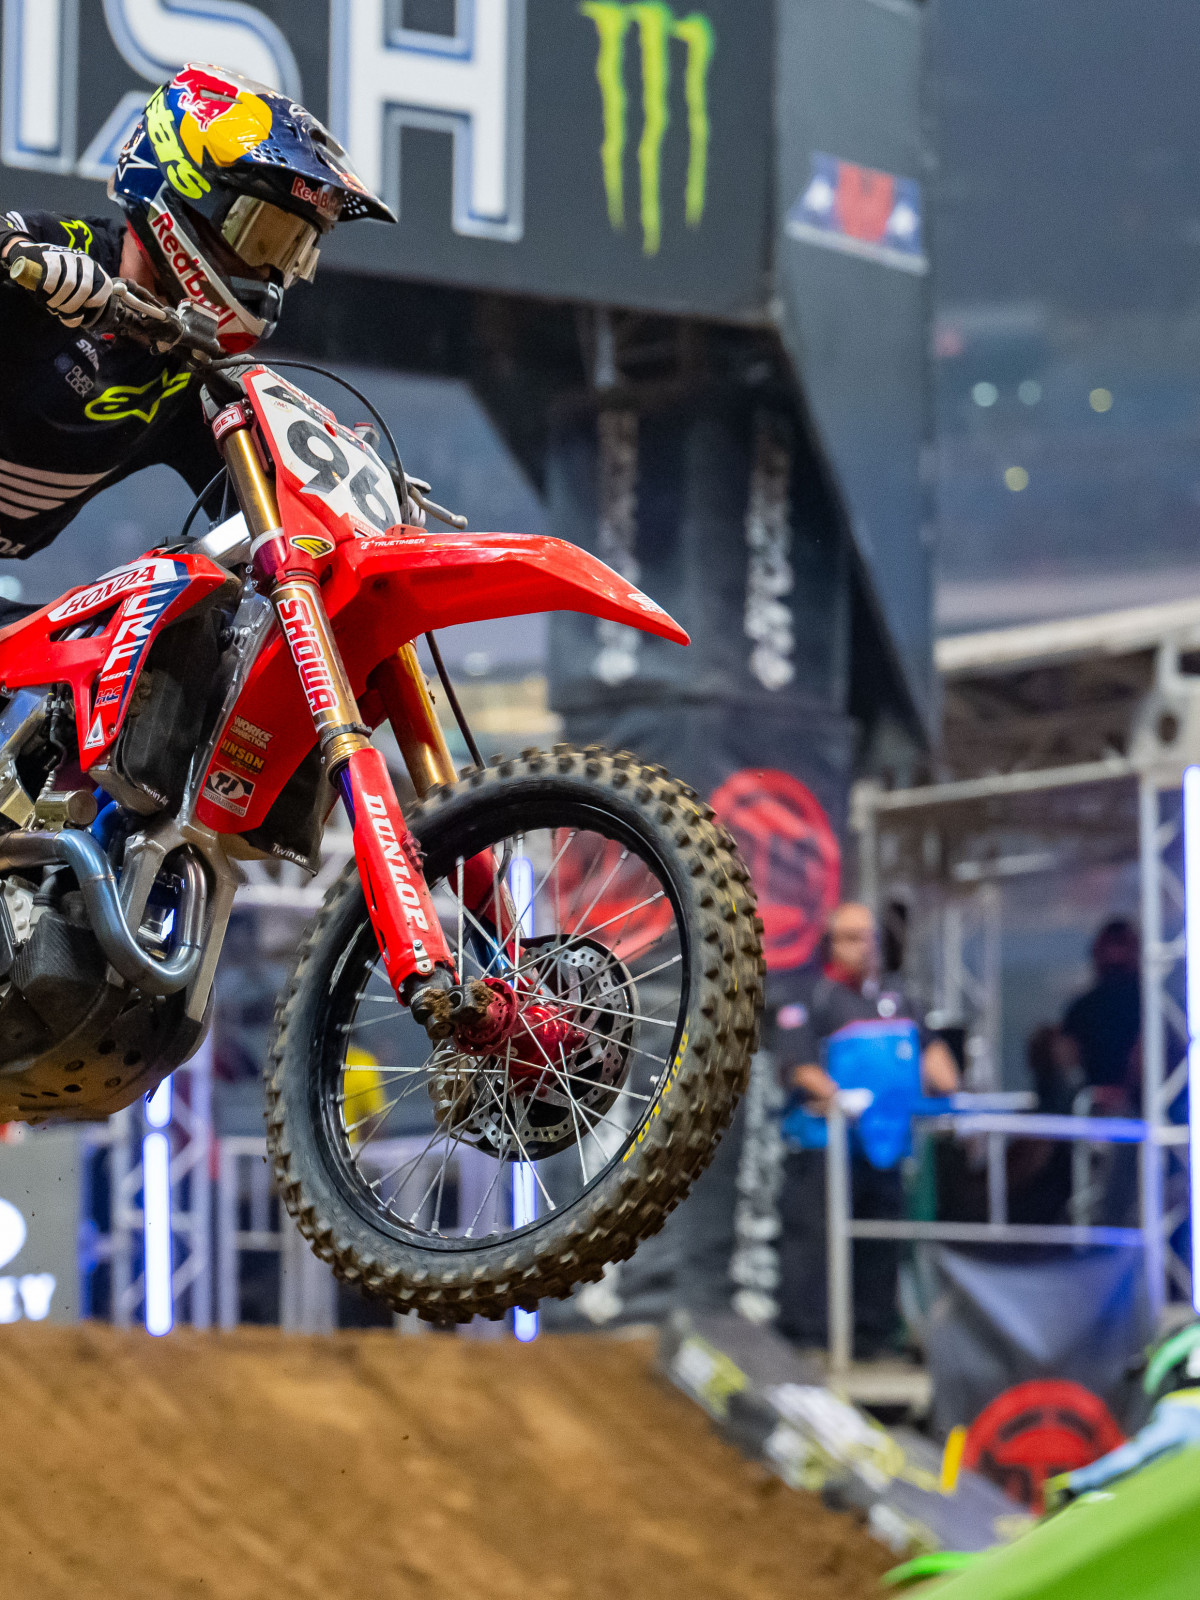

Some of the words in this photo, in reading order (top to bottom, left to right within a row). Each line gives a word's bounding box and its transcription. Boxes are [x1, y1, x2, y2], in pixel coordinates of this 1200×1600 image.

[286, 419, 397, 535] 96
[65, 564, 157, 617] HONDA
[101, 588, 171, 676] CRF
[276, 597, 340, 717] SHOWA
[100, 669, 133, 682] 450R
[234, 715, 274, 742] WORKS
[214, 771, 240, 796] TJ
[363, 791, 429, 932] DUNLOP
